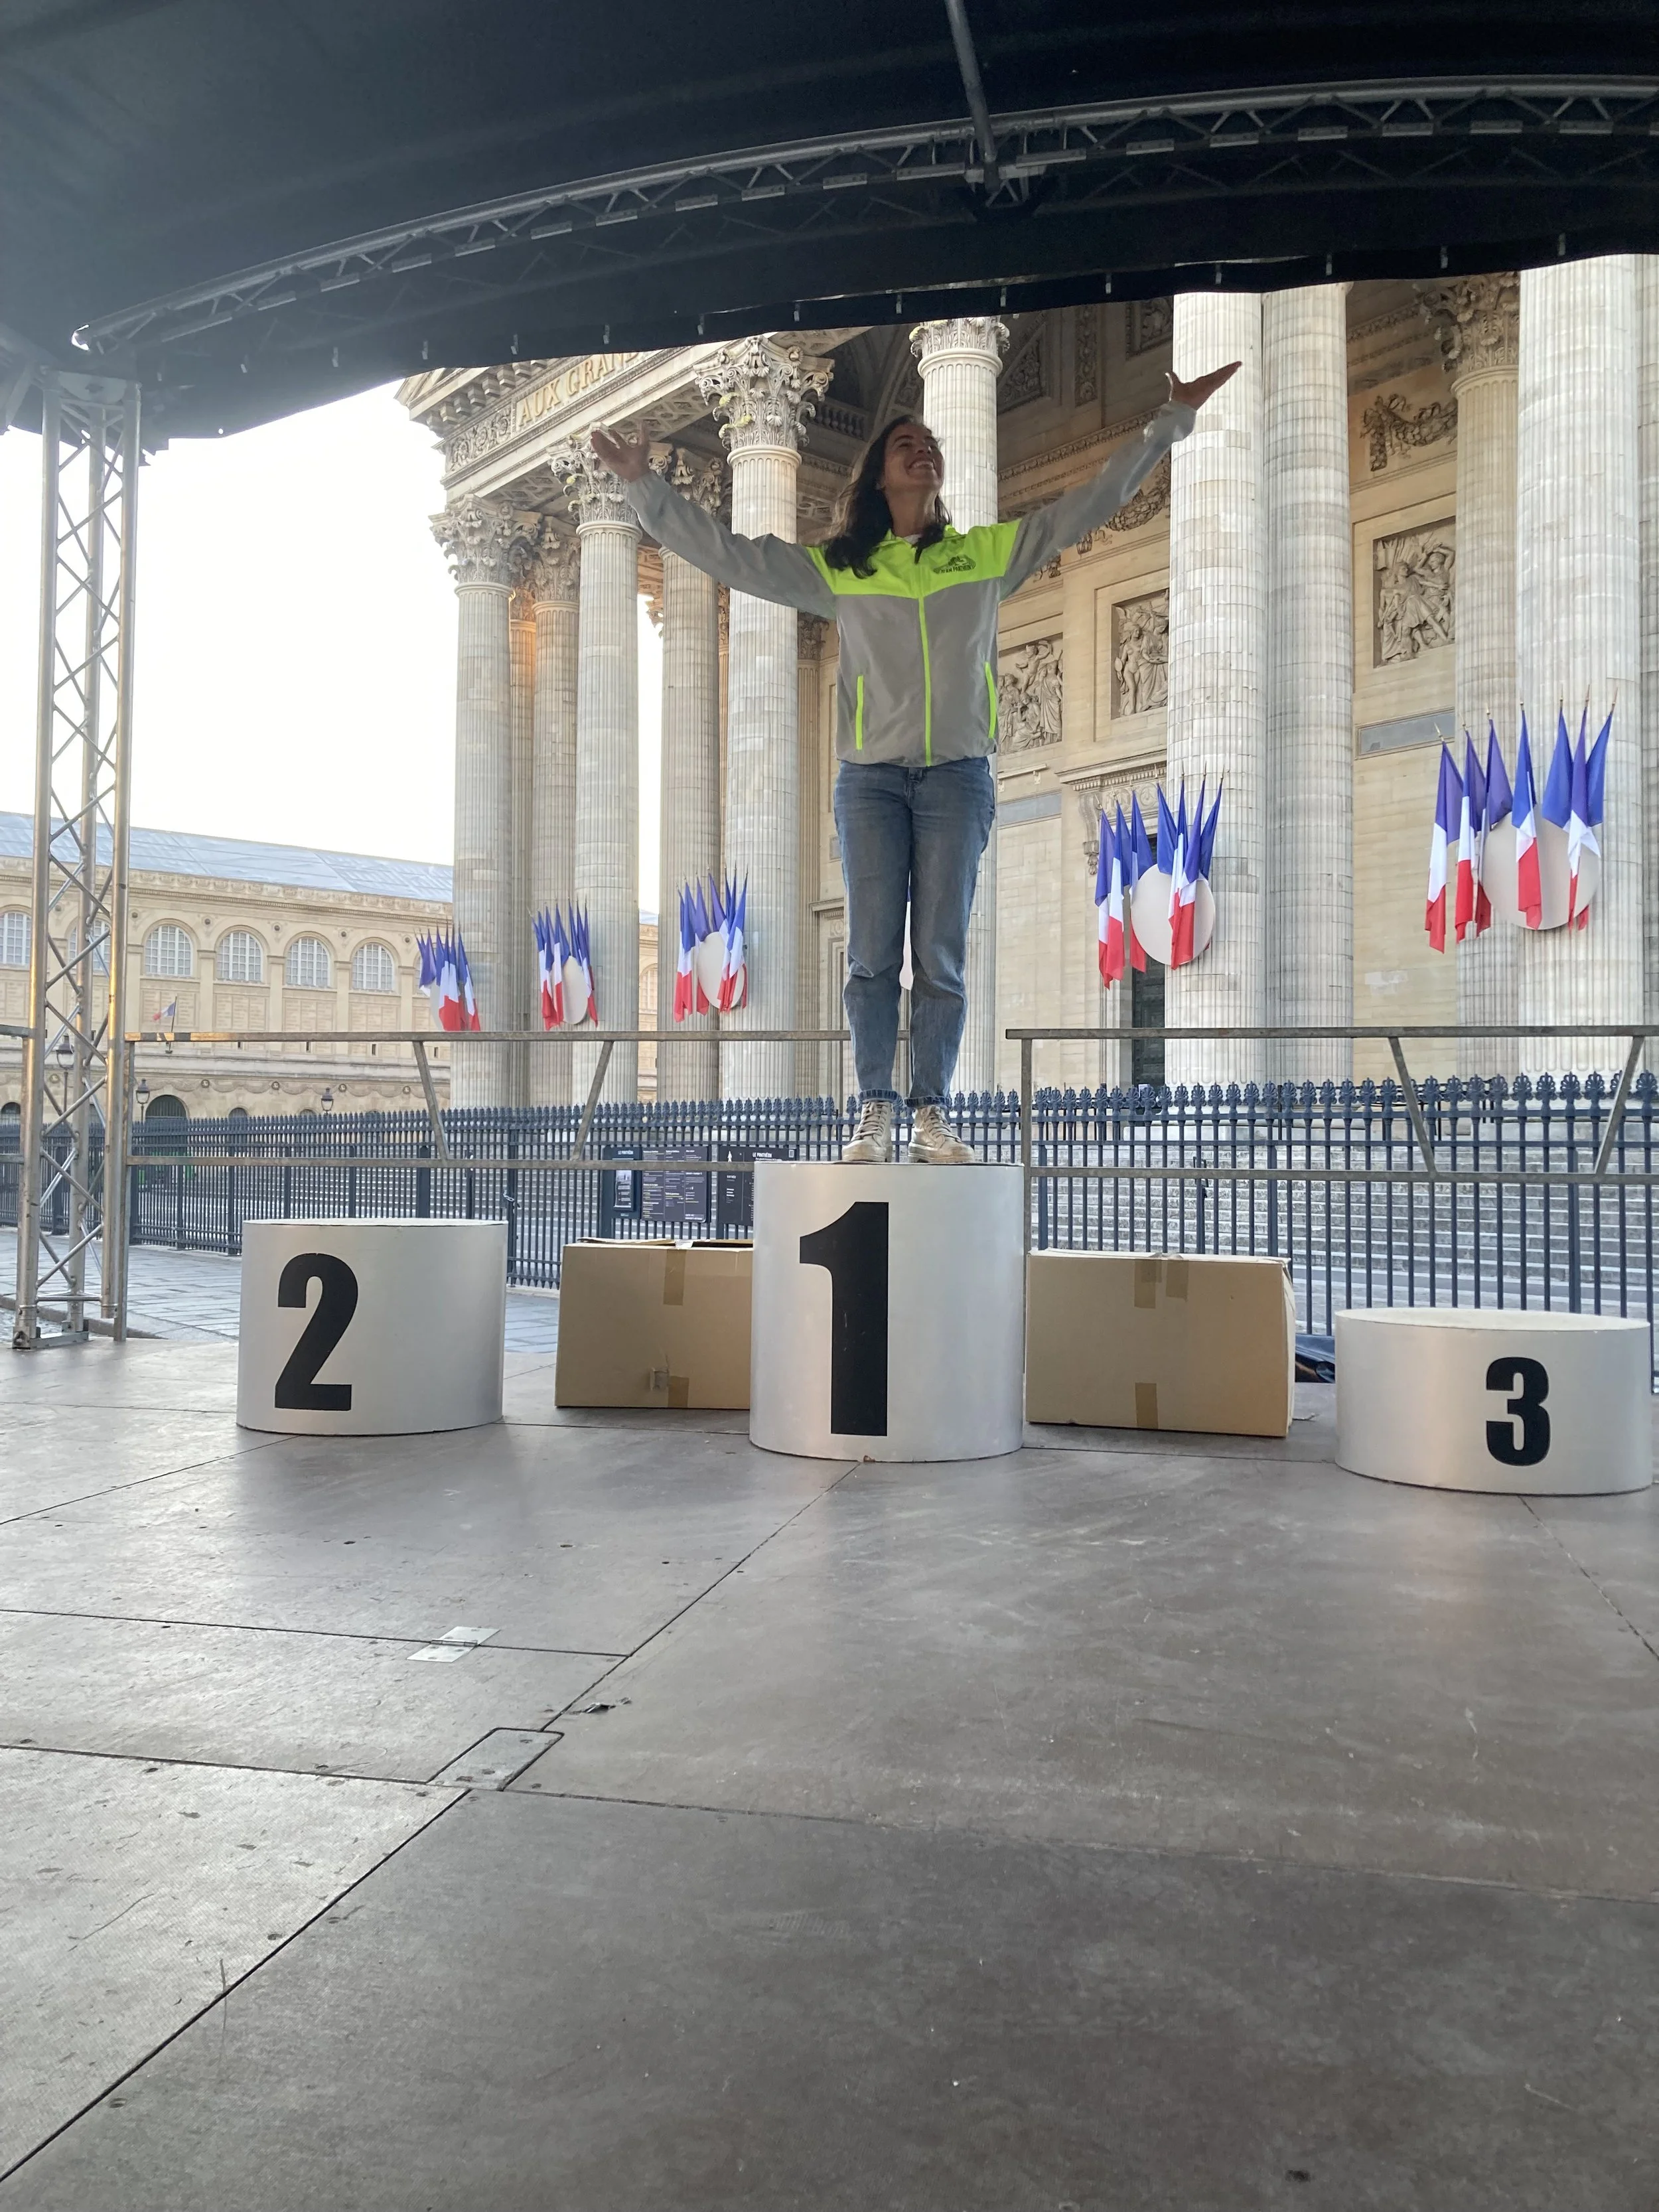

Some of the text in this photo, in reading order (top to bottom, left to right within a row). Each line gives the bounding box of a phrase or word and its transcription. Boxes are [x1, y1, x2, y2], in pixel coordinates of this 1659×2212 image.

[519, 378, 560, 427] AUX
[275, 1253, 358, 1411] 2
[800, 1201, 889, 1436] 1
[1486, 1357, 1551, 1467] 3
